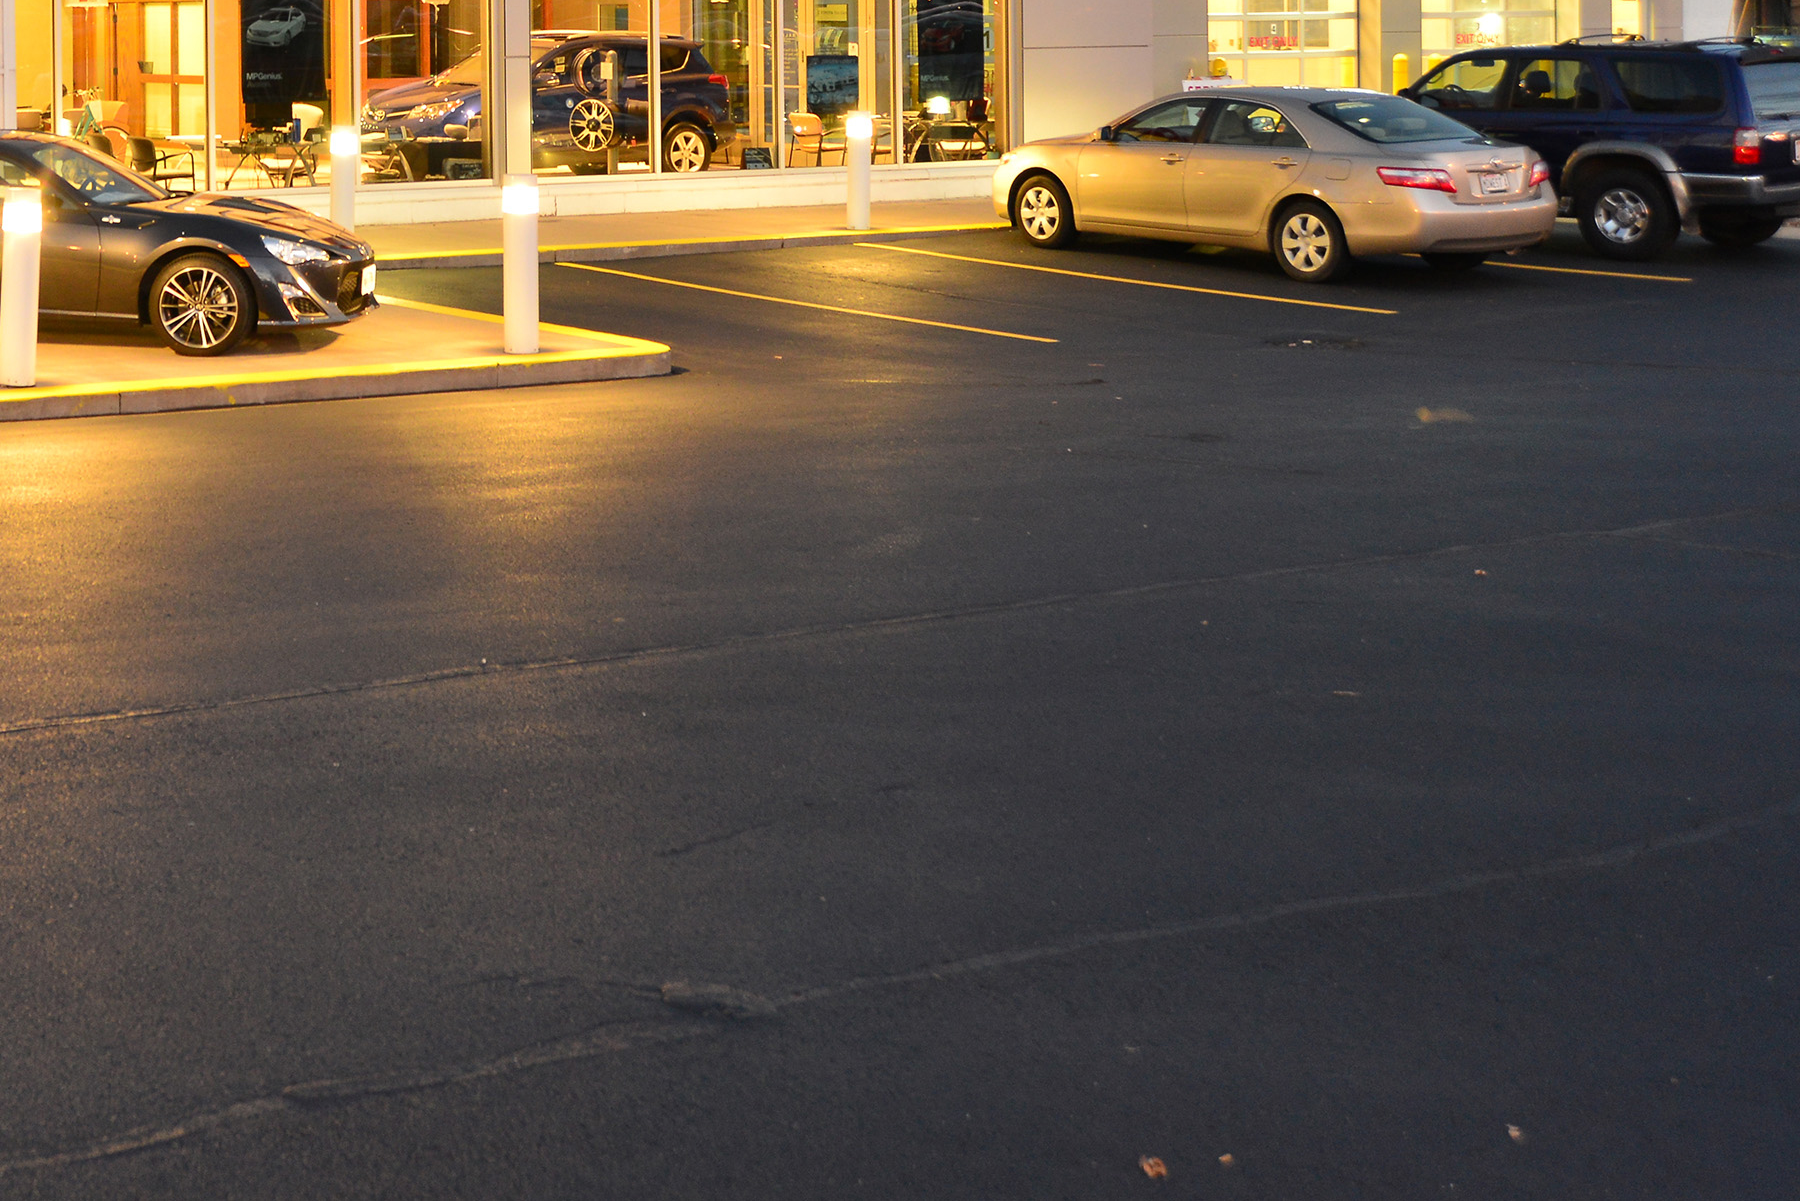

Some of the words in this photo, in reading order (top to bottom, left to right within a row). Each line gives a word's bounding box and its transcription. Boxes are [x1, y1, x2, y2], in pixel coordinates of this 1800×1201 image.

[1249, 36, 1270, 47] EXIT
[1272, 36, 1298, 47] ONLY
[1456, 33, 1474, 44] EXIT
